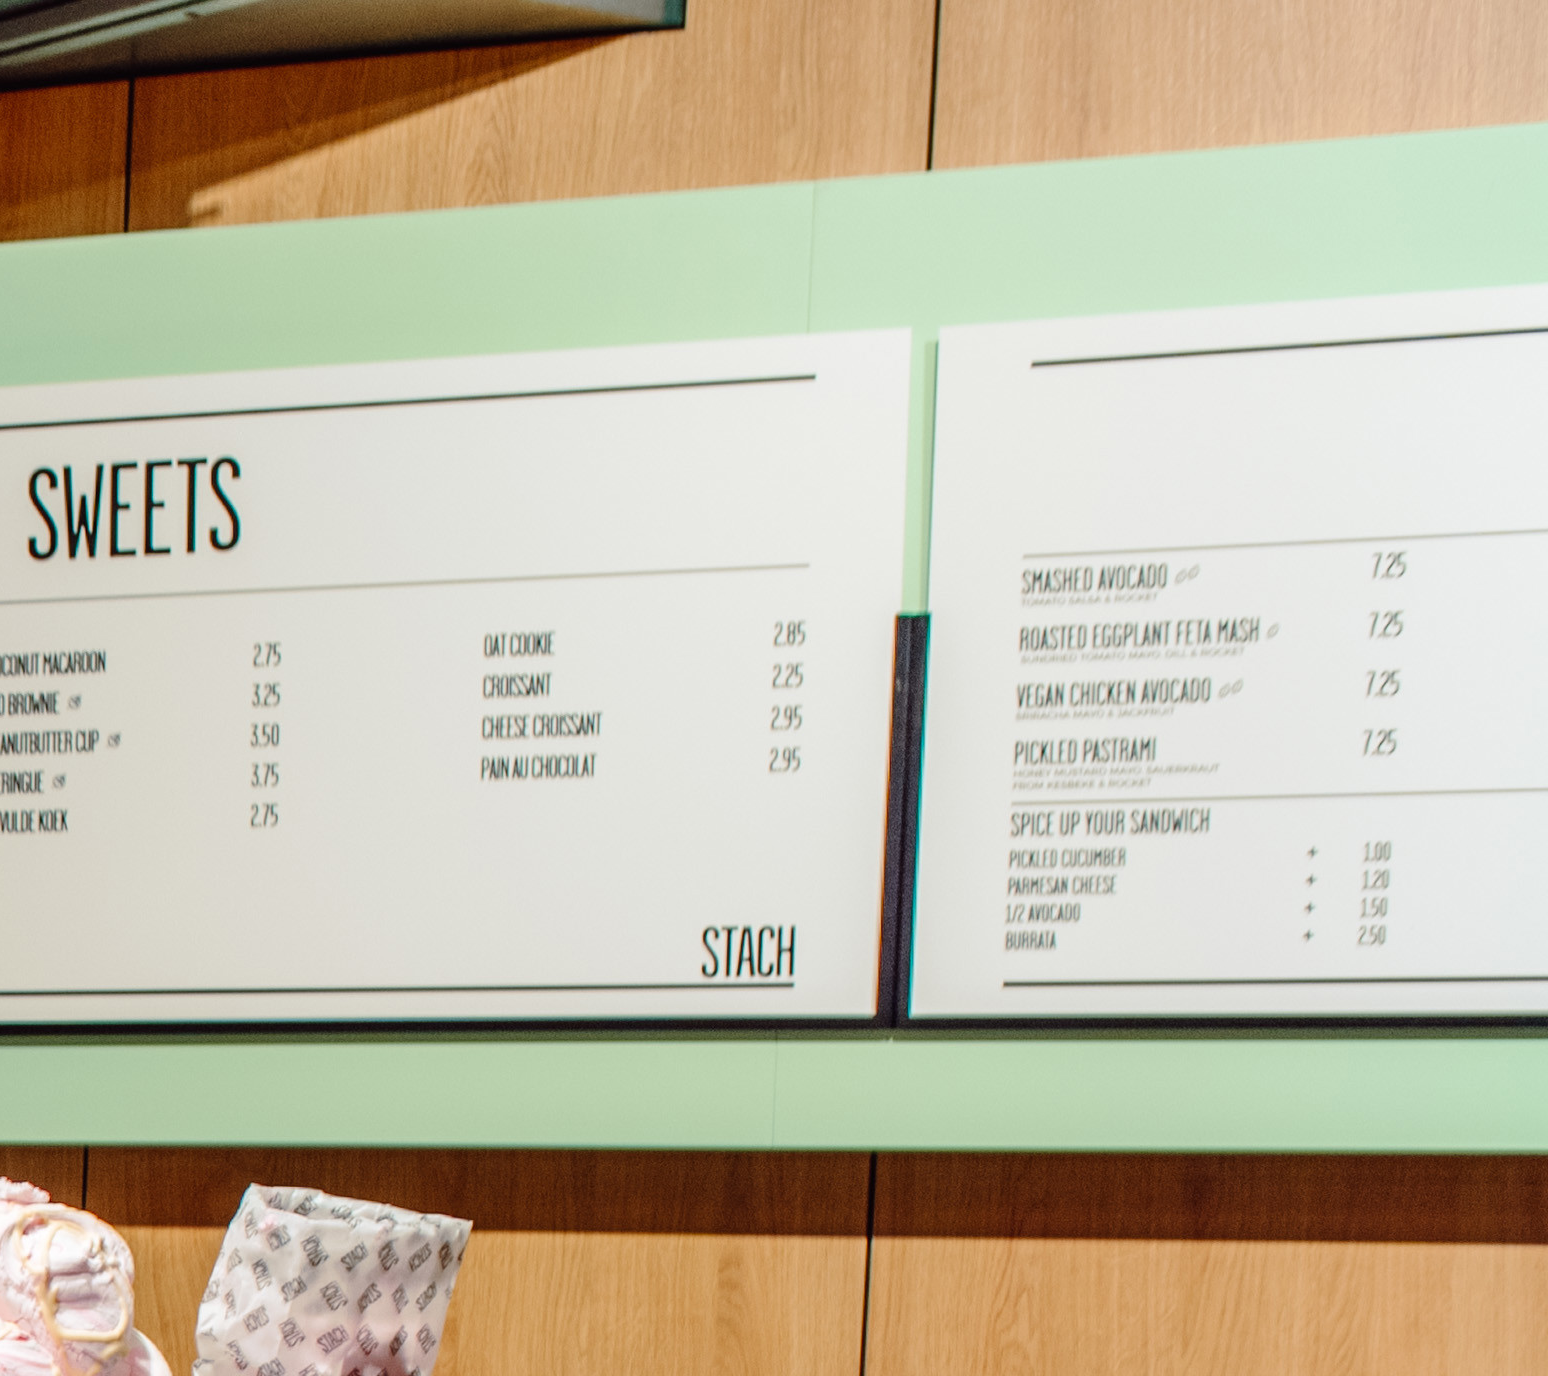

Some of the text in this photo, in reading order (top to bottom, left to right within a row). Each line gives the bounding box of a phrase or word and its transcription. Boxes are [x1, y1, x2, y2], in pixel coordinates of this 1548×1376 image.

[28, 456, 241, 559] SWEETS
[1022, 551, 1407, 595] SMASHED AVOCADO 7.25
[484, 621, 805, 657] OAT COOKIE 2.85
[1019, 610, 1404, 652] ROASTED EGGPLANT FETA MASH 7.25
[43, 650, 106, 675] MACAROON
[253, 643, 280, 667] 2.75
[483, 663, 803, 698] CROISSANT 2.25
[1017, 670, 1400, 709] VEGAN CHICKEN AVOCADO 7.25
[8, 693, 59, 715] BROWNIE
[252, 683, 280, 707] 3.25
[76, 730, 98, 752] CUP
[251, 724, 279, 747] 3.50
[482, 705, 802, 740] CHEESE CROISSANT 2.95
[481, 747, 800, 781] PAIN AU CHOCOLAT 2.95
[1014, 729, 1397, 767] PICKLED PASTRAMI 7.25
[251, 764, 278, 787] 3.75
[39, 810, 68, 832] KOEK
[251, 804, 278, 828] 2.75
[1011, 808, 1210, 838] SPICE UP YOUR SANDWICH
[702, 925, 795, 977] STACH
